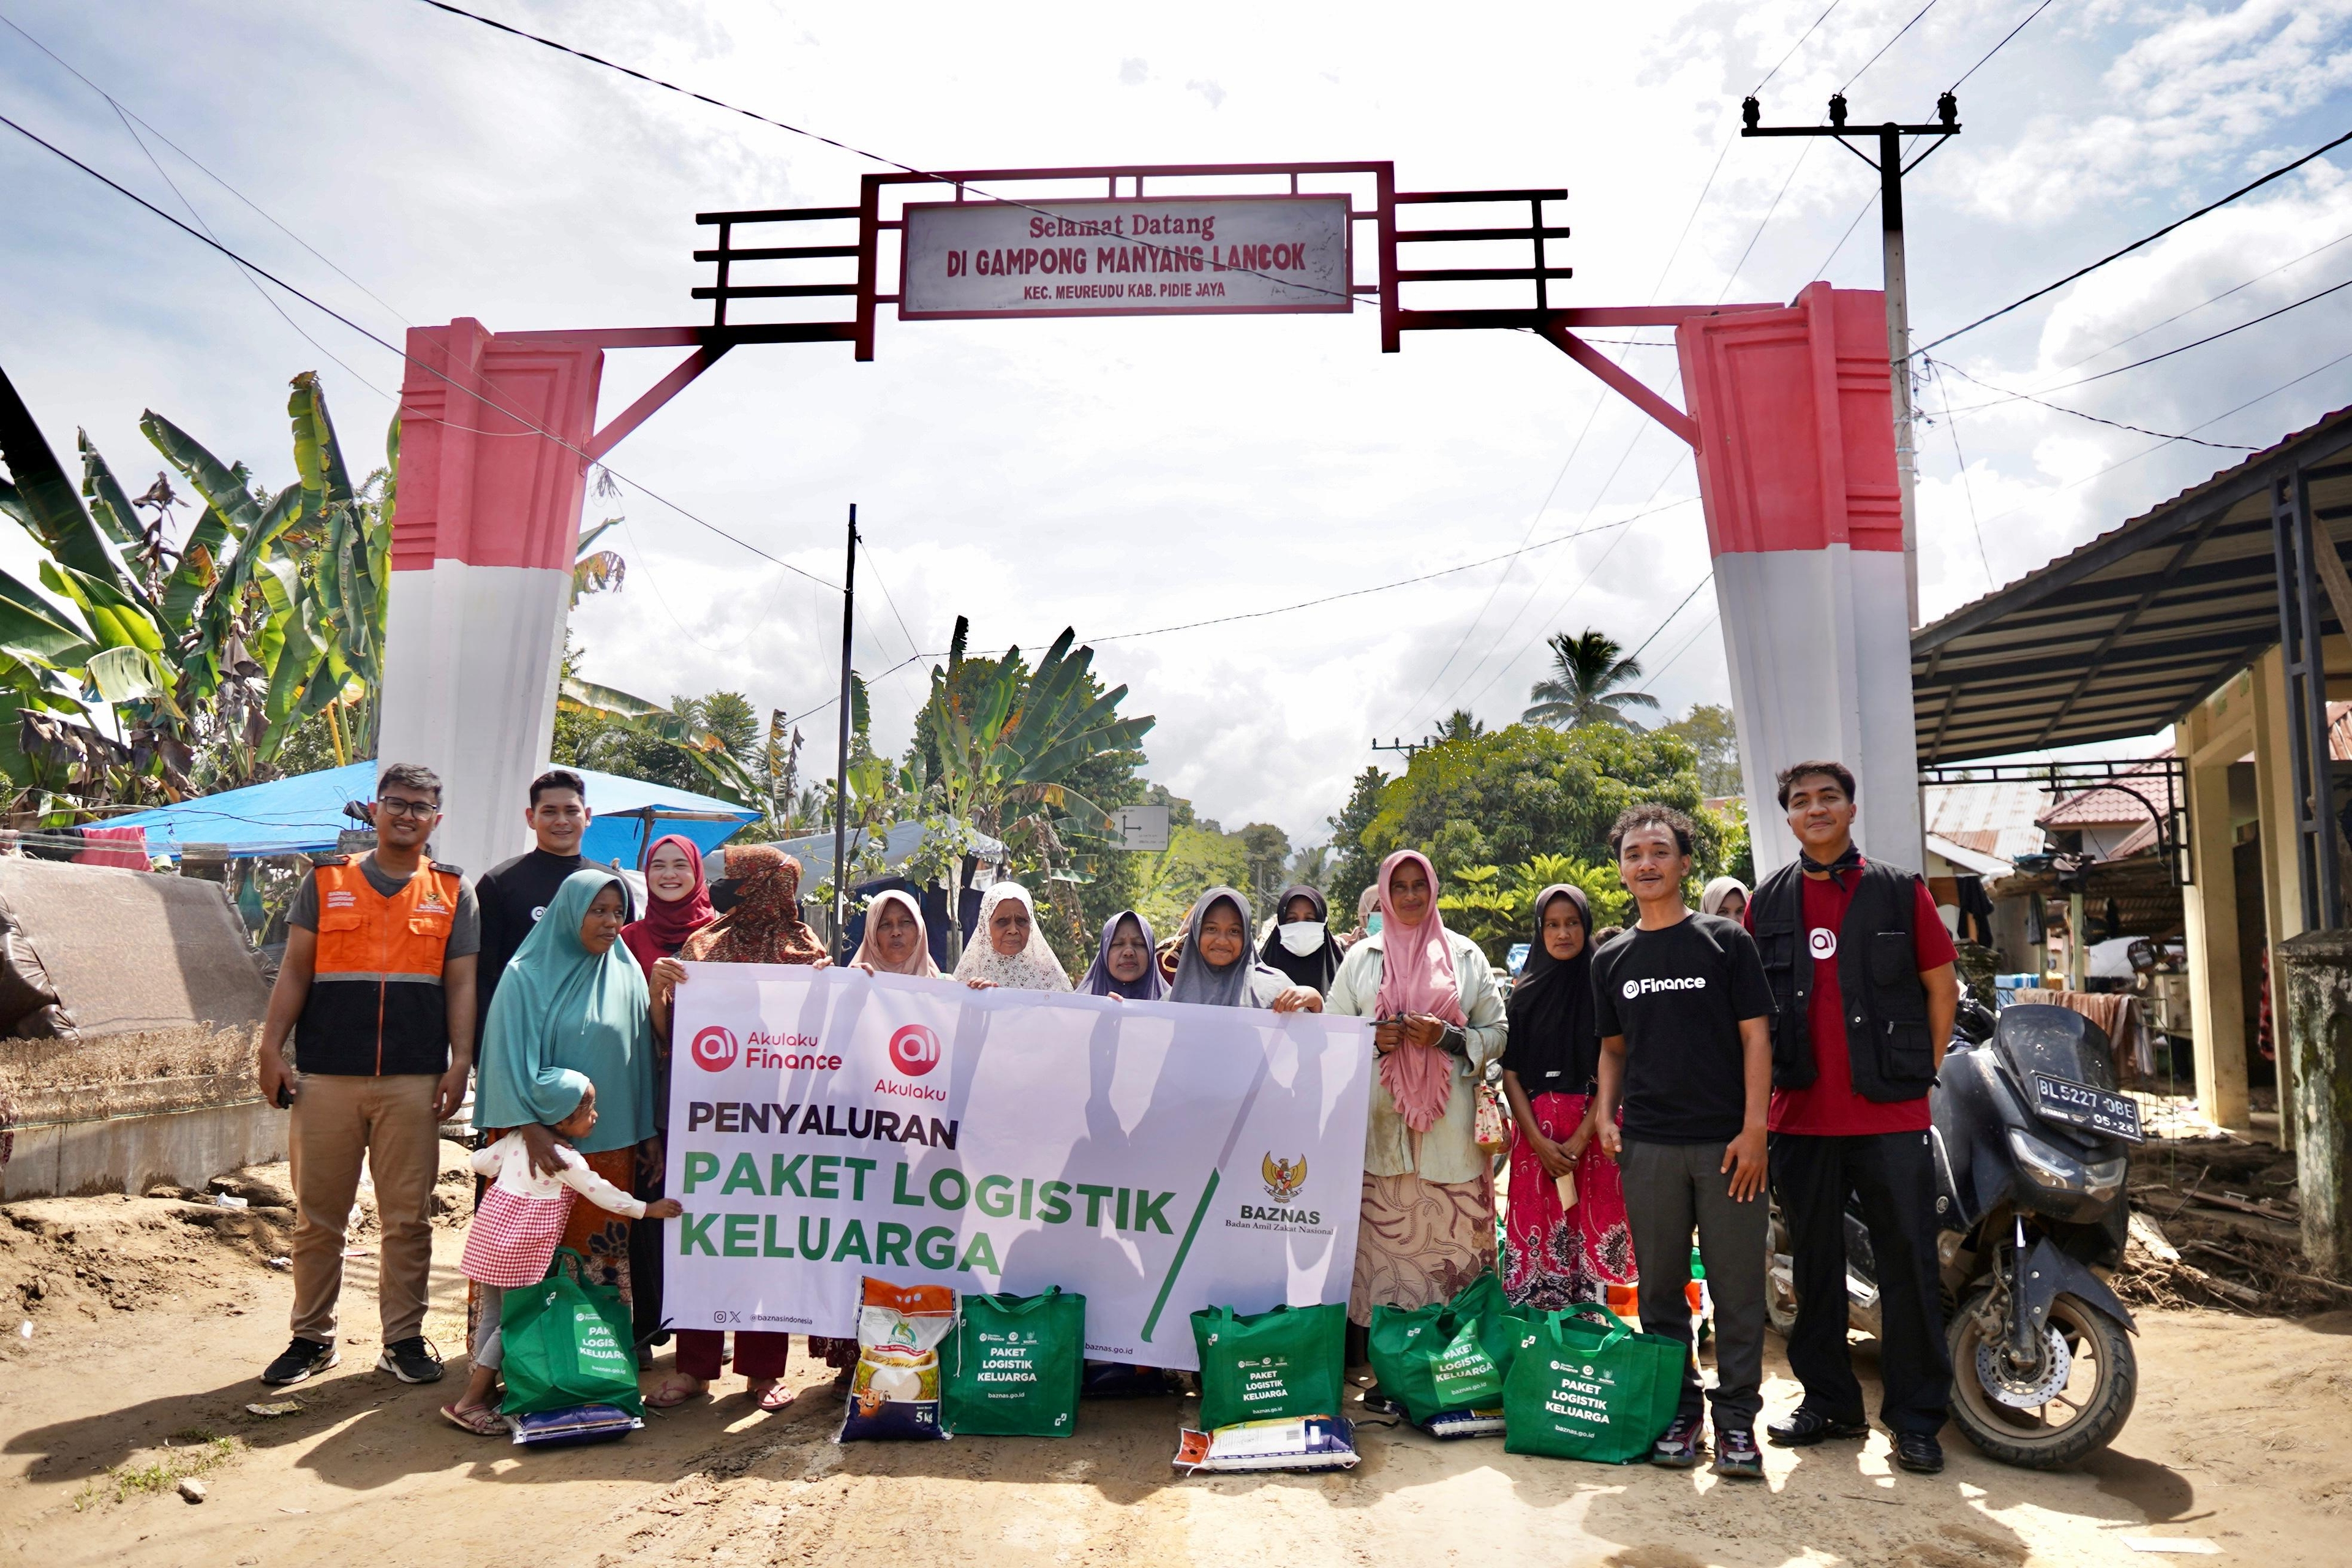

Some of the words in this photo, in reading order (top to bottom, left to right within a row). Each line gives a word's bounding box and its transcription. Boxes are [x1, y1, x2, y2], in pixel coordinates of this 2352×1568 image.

[1030, 214, 1123, 238] Selamat
[1132, 214, 1215, 241] Datang
[948, 250, 967, 277] DI
[976, 247, 1087, 276] GAMPONG
[1097, 245, 1204, 273] MANYANG
[1213, 243, 1306, 273] LANCOK
[1024, 285, 1052, 300] KEC.
[1056, 284, 1123, 299] MEUREUDU
[1128, 284, 1155, 298] KAB.
[1160, 283, 1191, 298] PIDIE
[1196, 282, 1225, 296] JAYA
[1641, 977, 1706, 993] Finance
[748, 1031, 818, 1047] Akulaku
[746, 1048, 842, 1071] Finance
[875, 1079, 946, 1101] Akulaku
[2039, 1079, 2060, 1099] BL
[2060, 1085, 2097, 1107] 5227
[688, 1102, 959, 1150] PENYALURAN
[683, 1152, 876, 1200] PAKET
[892, 1162, 1177, 1235] LOGISTIK
[1240, 1205, 1321, 1225] BAZNAS
[1226, 1219, 1250, 1229] Badan
[1273, 1224, 1296, 1232] Zakat
[1298, 1226, 1333, 1235] Nasional
[679, 1213, 1001, 1276] KELUARGA
[750, 1314, 813, 1325] @baznasindonesia
[582, 1338, 619, 1348] LOGIS
[1085, 1343, 1133, 1354] baznas.go.id
[990, 1348, 1027, 1357] PAKET
[1443, 1344, 1472, 1360] PAKET
[982, 1360, 1033, 1370] LOGISTIK
[1439, 1354, 1485, 1372] LOGISTIK
[977, 1373, 1037, 1382] KELUARGA
[1250, 1370, 1277, 1381] PAKET
[1435, 1362, 1494, 1382] KELUARGA
[1246, 1379, 1283, 1391] LOGISTIK
[1562, 1378, 1602, 1395] PAKET
[1243, 1389, 1288, 1401] KELUARGA
[1552, 1390, 1607, 1410] LOGISTIK
[915, 1411, 923, 1423] 5
[924, 1412, 933, 1424] kg
[1545, 1401, 1610, 1424] KELUARGA
[1555, 1424, 1595, 1438] baznas.go.id
